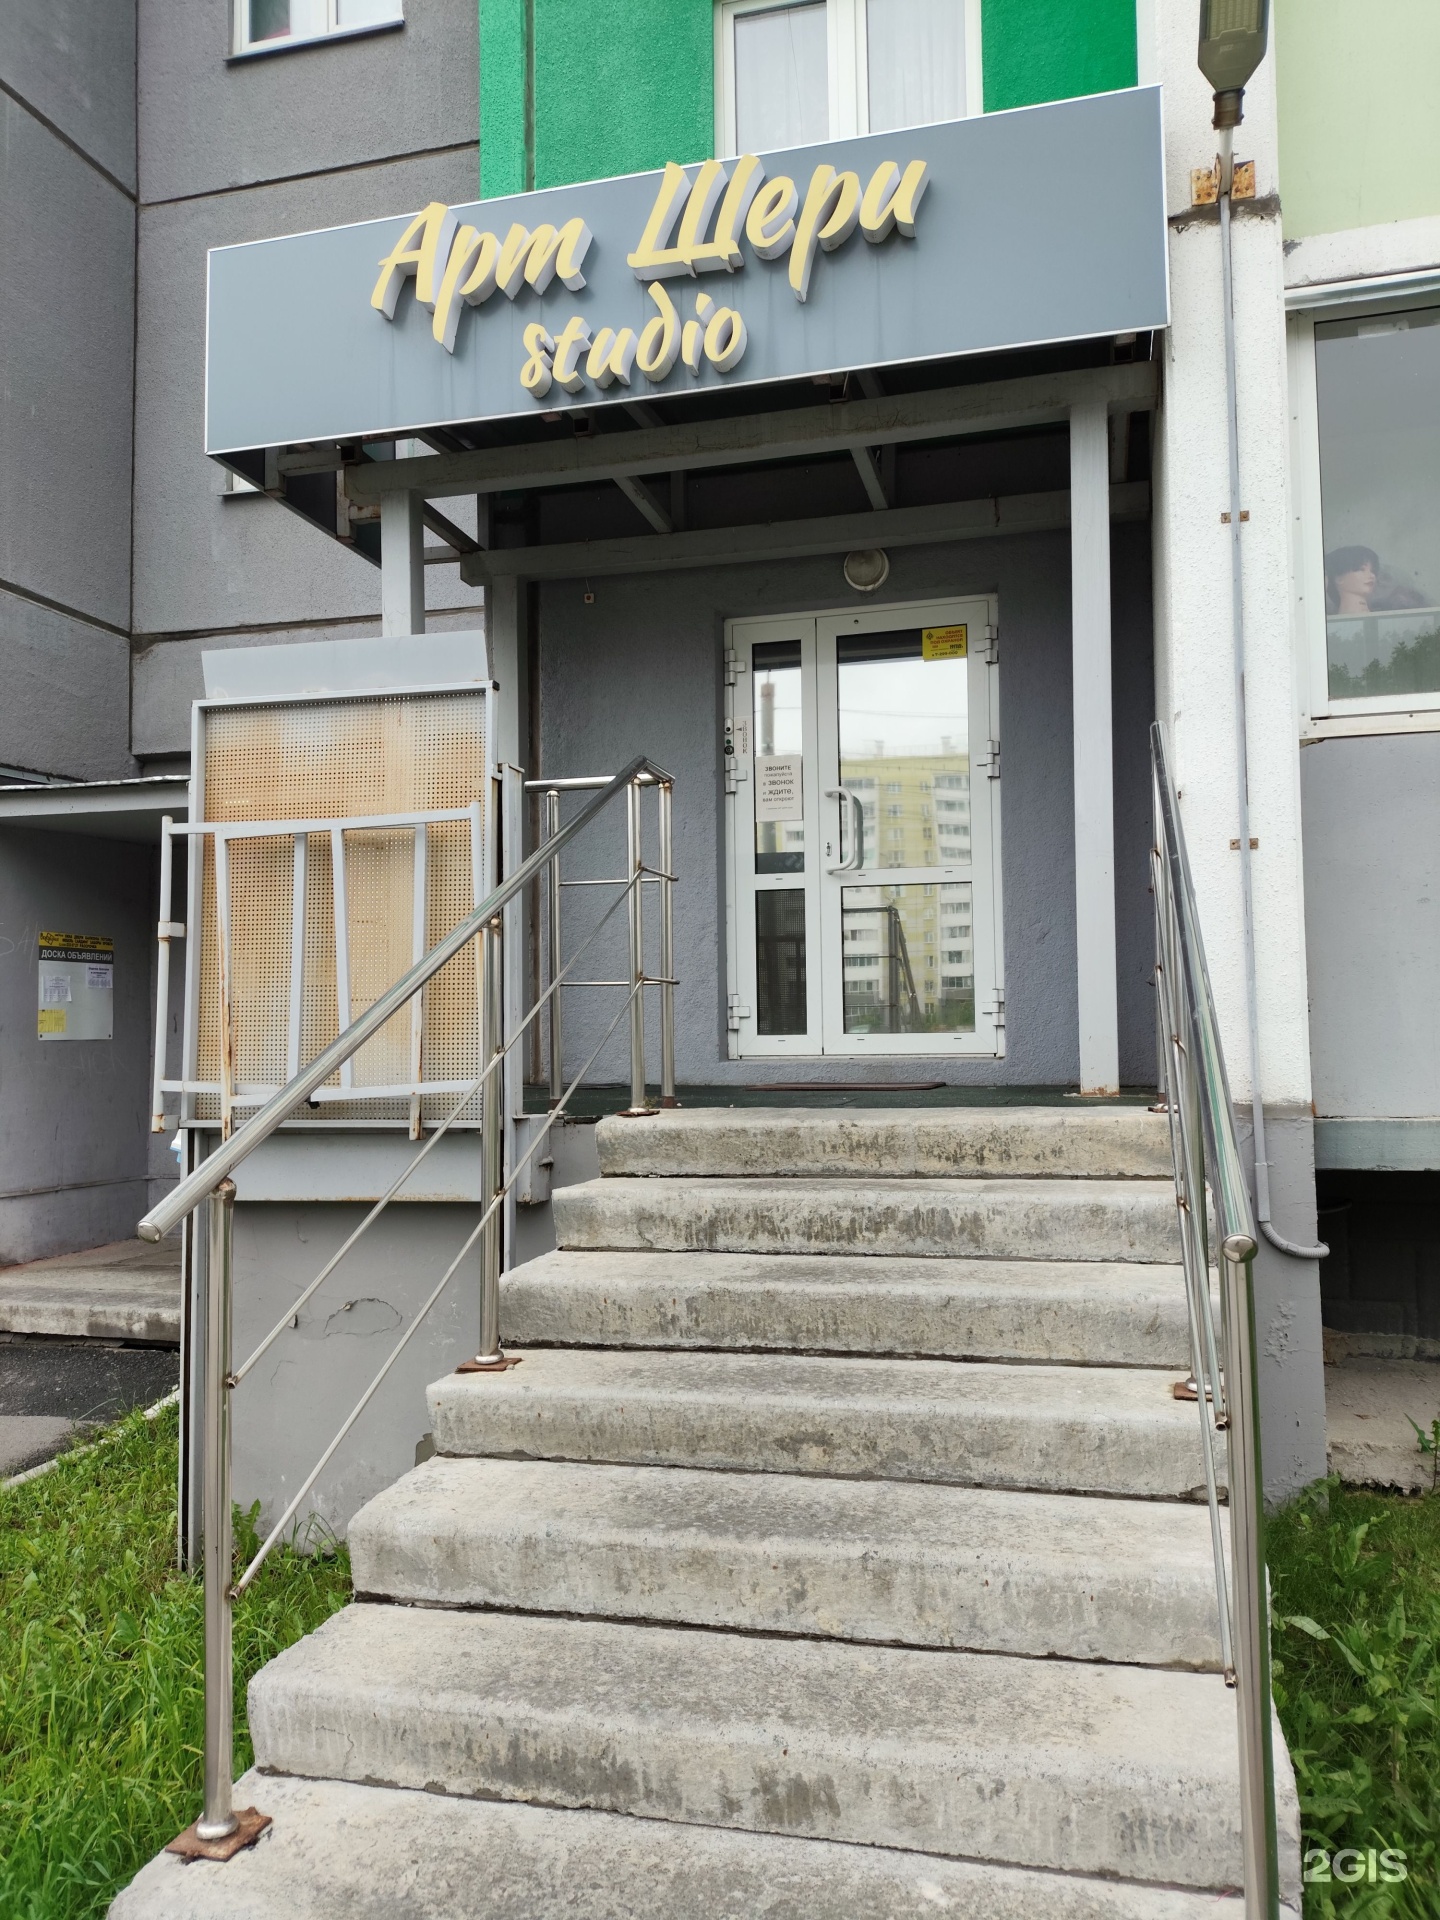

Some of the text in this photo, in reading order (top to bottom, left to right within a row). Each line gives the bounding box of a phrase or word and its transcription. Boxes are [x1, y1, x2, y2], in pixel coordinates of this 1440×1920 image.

[371, 154, 931, 353] Арт Шери
[520, 281, 748, 398] studio
[41, 949, 112, 961] ДОСКА ОБЪЯВЛЕНИЙ
